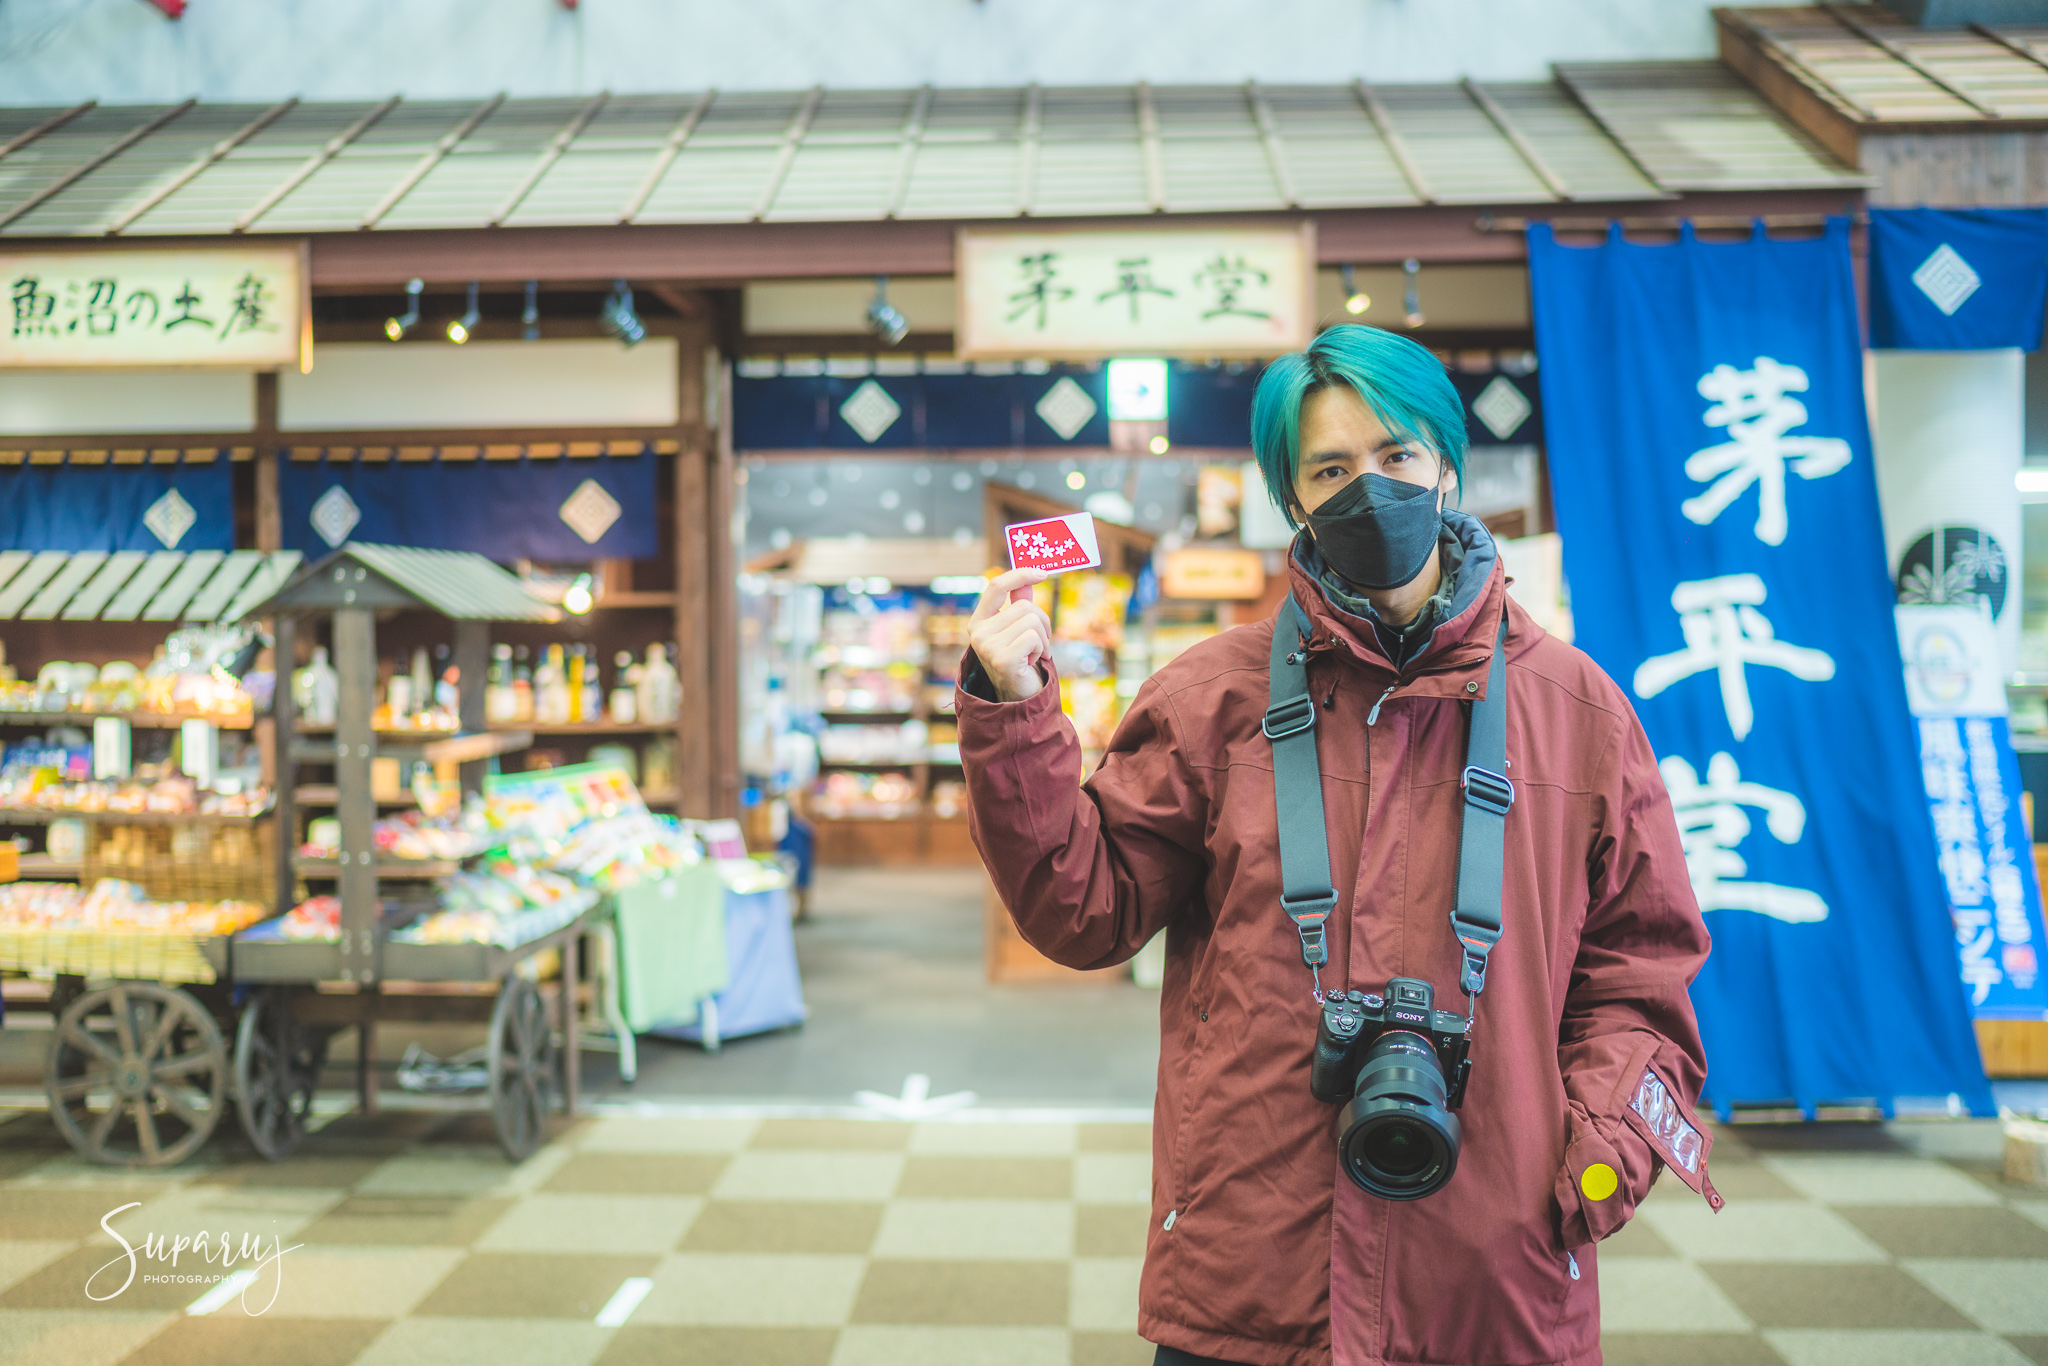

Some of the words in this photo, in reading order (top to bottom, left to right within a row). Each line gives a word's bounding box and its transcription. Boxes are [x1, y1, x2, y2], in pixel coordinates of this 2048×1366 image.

[12, 269, 279, 340] 魚沼の土産
[1005, 253, 1271, 329] 茅平堂
[1633, 356, 1852, 924] 茅平堂
[1395, 1011, 1425, 1022] SONY
